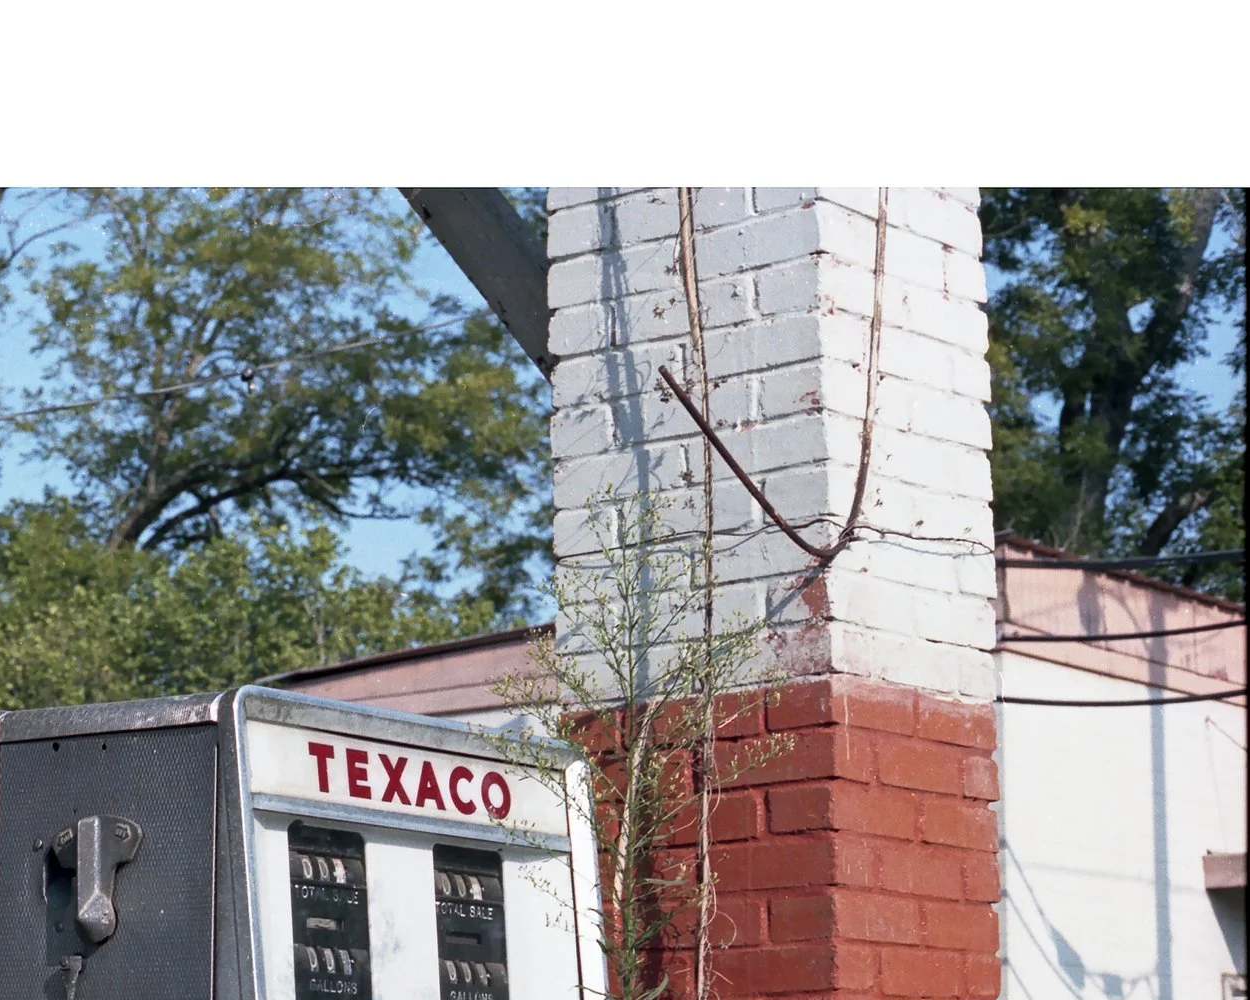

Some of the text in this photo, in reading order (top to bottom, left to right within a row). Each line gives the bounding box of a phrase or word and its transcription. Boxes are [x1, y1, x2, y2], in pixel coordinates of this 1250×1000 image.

[308, 741, 512, 820] TEXACO
[435, 902, 493, 921] TOTAL SALE
[309, 979, 358, 995] GALLONS
